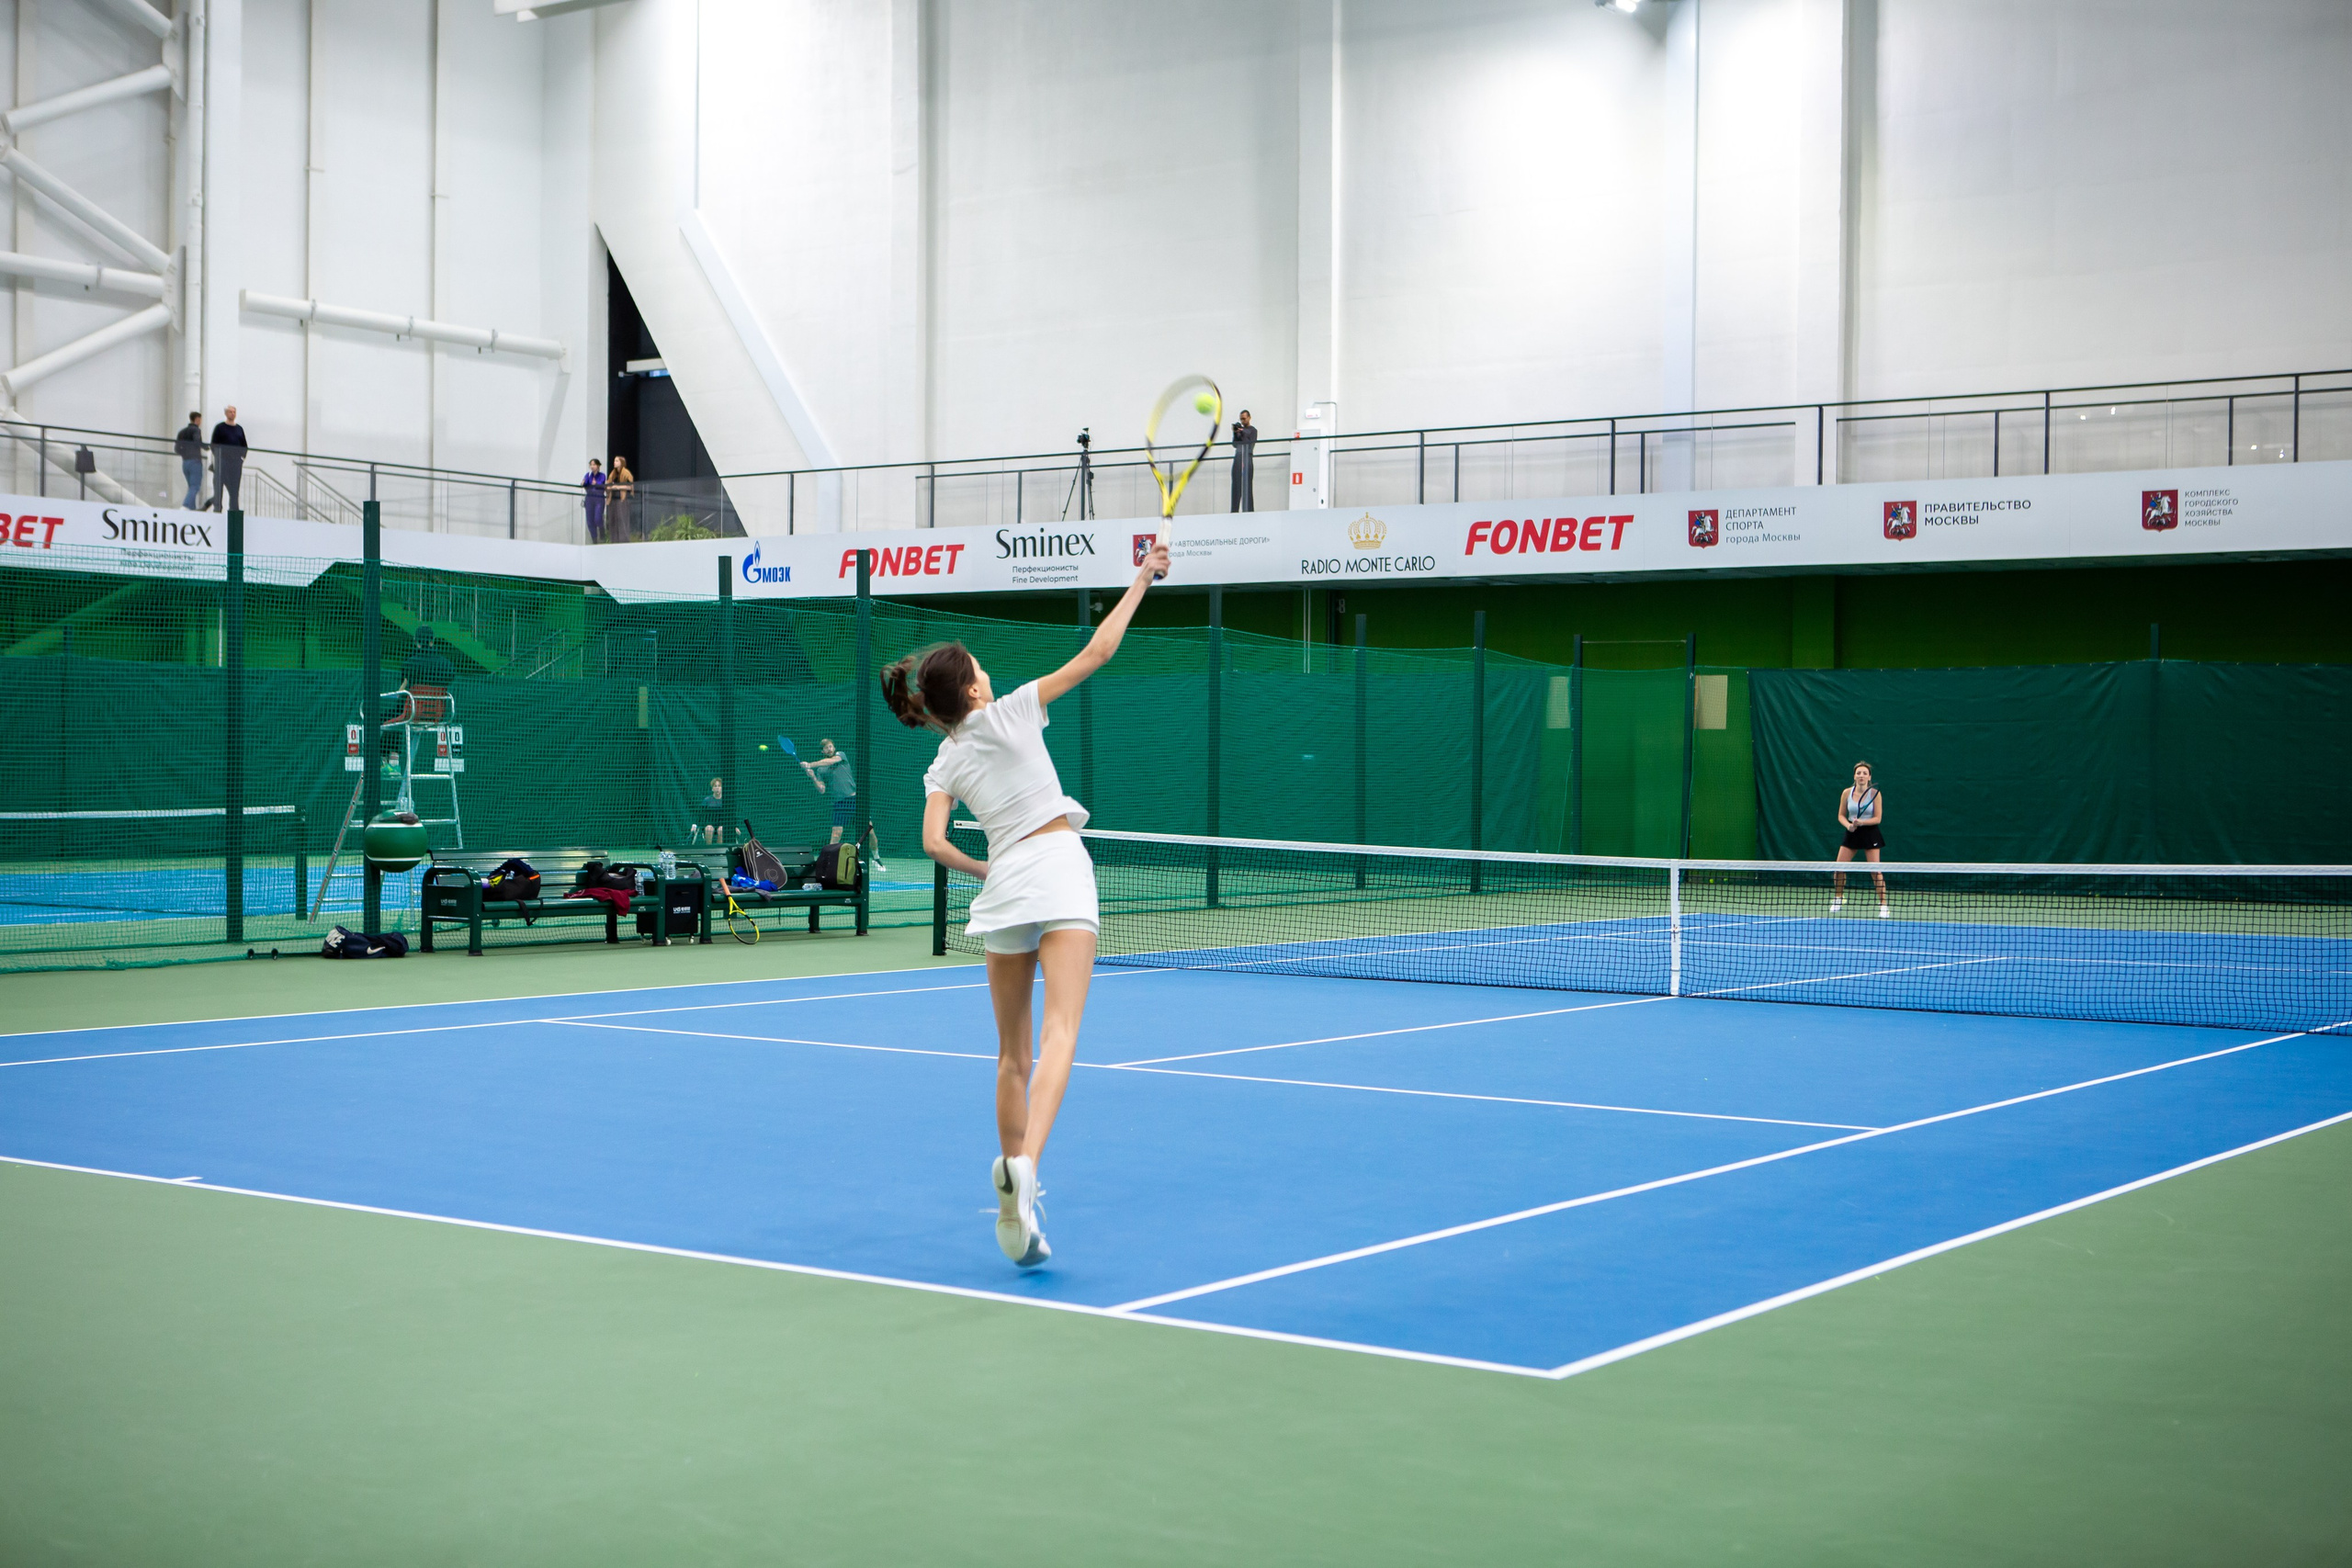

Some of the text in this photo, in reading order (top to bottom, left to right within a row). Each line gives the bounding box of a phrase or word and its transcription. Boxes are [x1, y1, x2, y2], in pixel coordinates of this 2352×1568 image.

[2184, 489, 2231, 498] КОМПЛЕКС
[1924, 500, 2031, 513] ПРАВИТЕЛЬСТВО
[2184, 498, 2239, 508] ГОРОДСКОГО
[1724, 506, 1797, 520] ДЕПАРТАМЕНТ
[2184, 508, 2233, 517] ХОЗЯЙСТВА
[1725, 521, 1764, 531] СПОРТА
[1924, 515, 1979, 526] МОСКВЫ
[2184, 519, 2221, 527] МОСКВЫ
[102, 508, 213, 548] Sminex
[1464, 514, 1634, 556] FONBET
[1725, 533, 1801, 545] города Москвы
[995, 527, 1096, 559] Sminex
[1169, 550, 1185, 559] рода
[1012, 565, 1080, 574] Перфекционисты
[1301, 555, 1436, 575] RADIO MONTE CARLO
[762, 566, 791, 583] МОЭК
[1012, 575, 1079, 584] Fine Development
